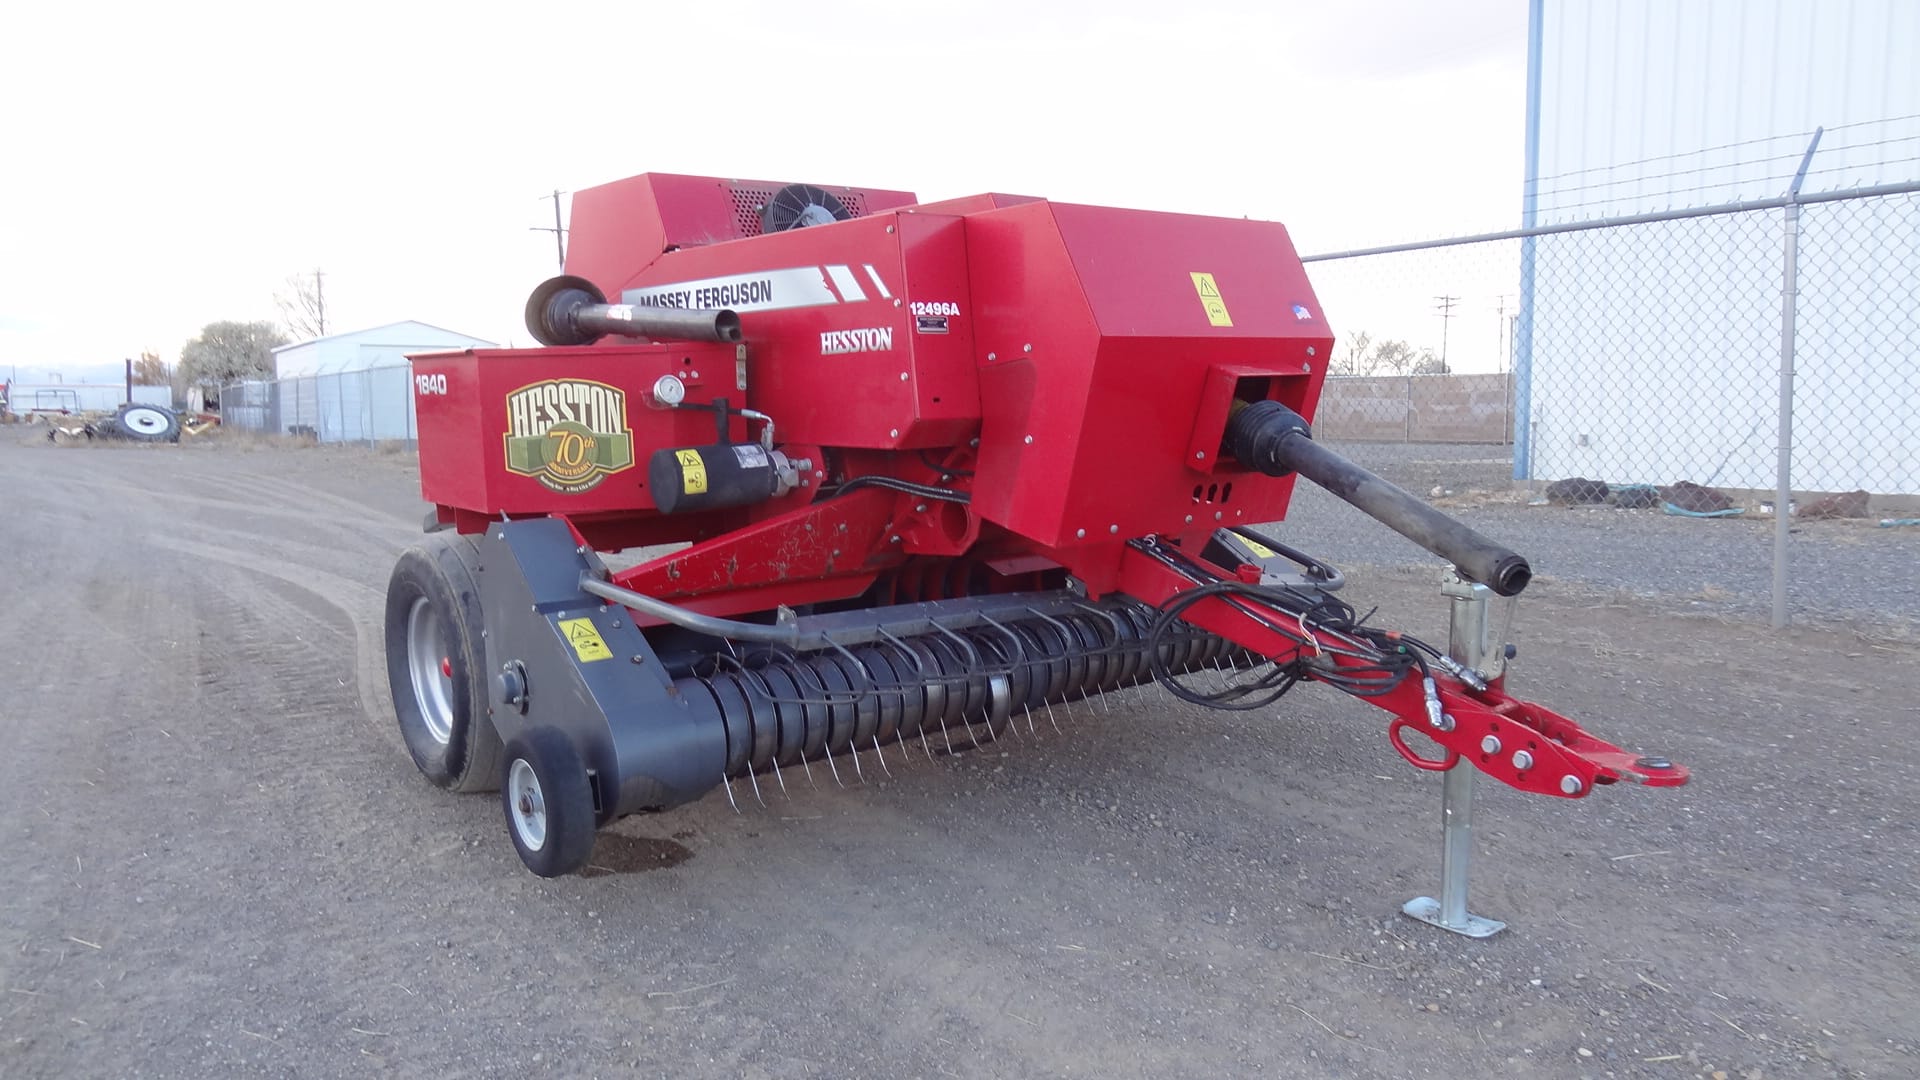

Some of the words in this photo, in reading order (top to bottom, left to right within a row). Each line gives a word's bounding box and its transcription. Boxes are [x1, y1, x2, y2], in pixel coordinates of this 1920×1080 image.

[696, 280, 772, 310] FERGUSON
[909, 301, 961, 316] 12496A
[820, 326, 893, 356] HESSTON
[416, 374, 447, 396] 1840
[511, 383, 621, 438] HESSTON
[549, 431, 596, 466] 70th
